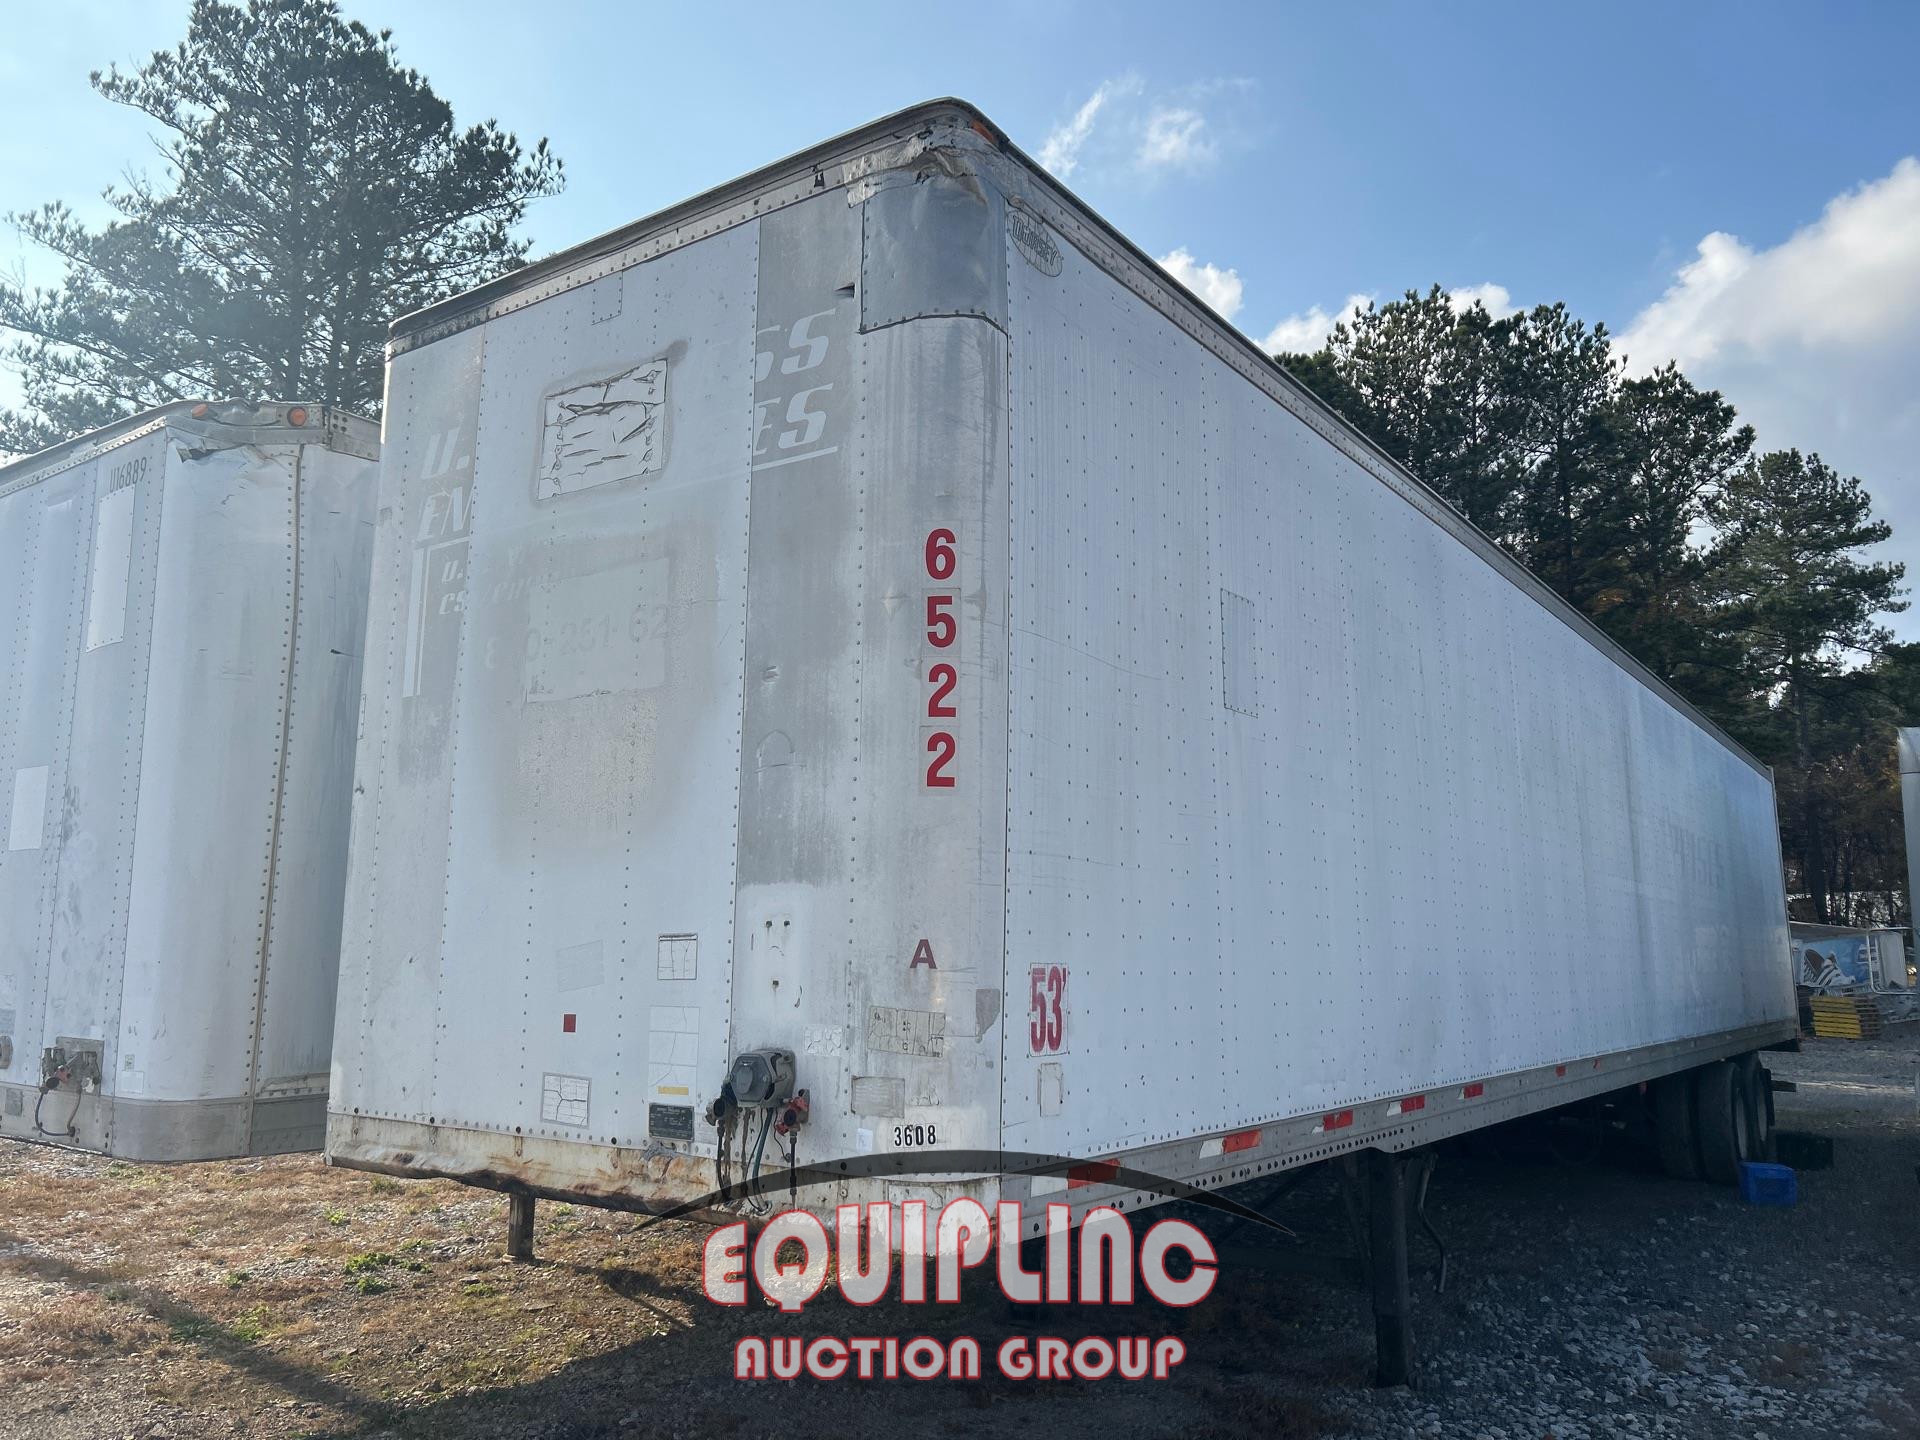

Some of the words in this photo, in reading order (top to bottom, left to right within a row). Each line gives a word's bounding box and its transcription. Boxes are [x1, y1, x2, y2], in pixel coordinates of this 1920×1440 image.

[109, 457, 147, 493] U16889
[909, 939, 937, 970] A
[893, 1124, 937, 1147] 3608
